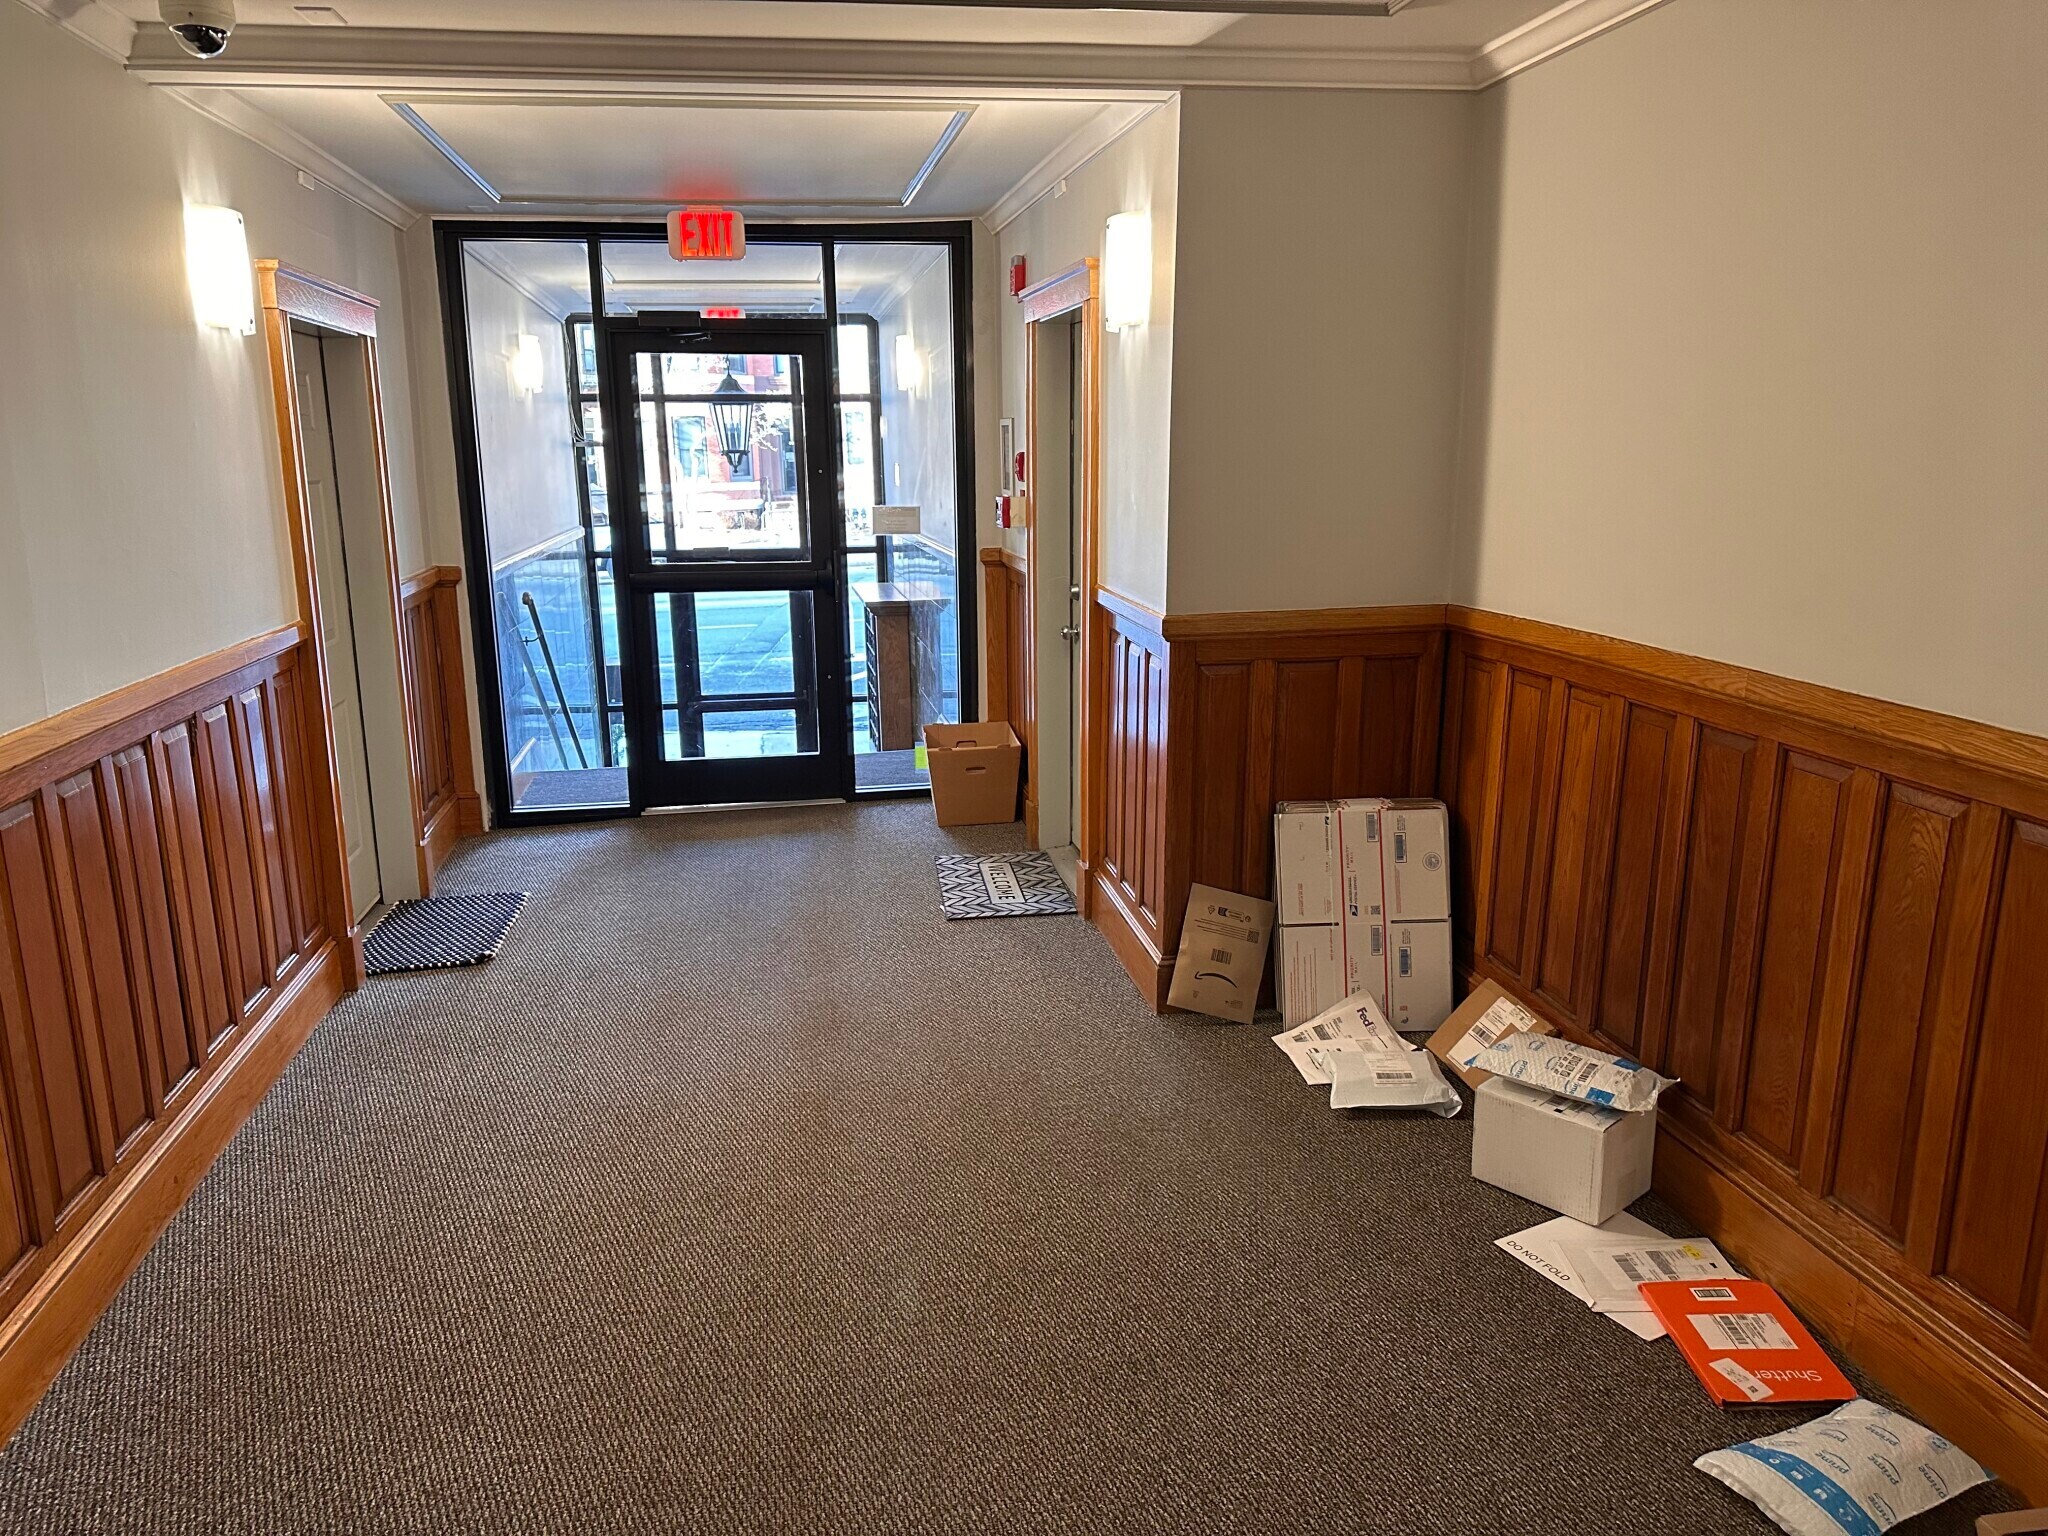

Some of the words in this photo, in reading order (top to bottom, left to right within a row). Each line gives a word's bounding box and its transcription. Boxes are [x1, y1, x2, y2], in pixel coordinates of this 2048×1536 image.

[679, 212, 735, 257] EXIT
[988, 864, 1016, 901] WELCOME
[1514, 1060, 1529, 1079] prime
[1506, 1240, 1523, 1251] DO
[1521, 1250, 1546, 1264] NOT
[1542, 1263, 1571, 1281] FOLD
[1754, 1369, 1823, 1382] Shutter
[1864, 1425, 1899, 1447] prime
[1815, 1451, 1850, 1474] prime
[1867, 1454, 1900, 1486] prime
[1918, 1465, 1948, 1499] prime
